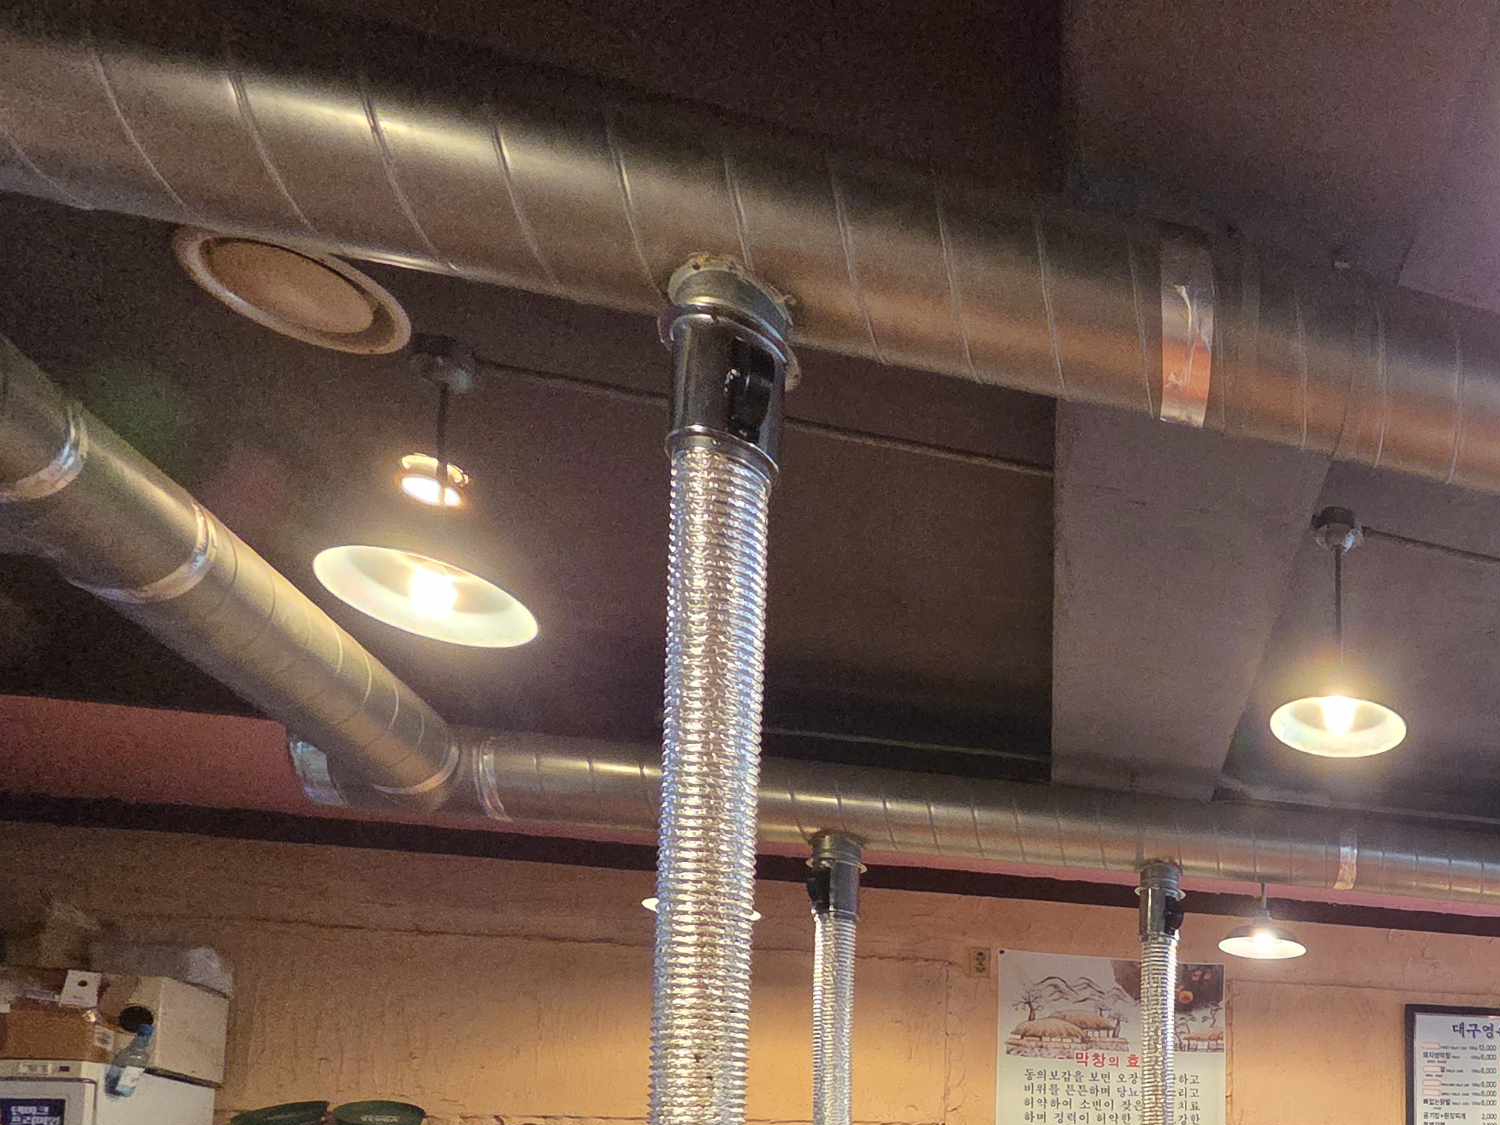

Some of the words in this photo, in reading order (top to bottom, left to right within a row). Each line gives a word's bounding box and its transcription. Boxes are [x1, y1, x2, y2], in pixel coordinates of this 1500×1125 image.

[1075, 1052, 1120, 1068] 막창의
[1024, 1068, 1085, 1083] 동의보감을
[1116, 1073, 1141, 1084] 오장
[1024, 1083, 1060, 1097] 비위를
[1065, 1084, 1111, 1098] 튼튼하며
[1116, 1086, 1140, 1098] 당뇨
[1024, 1097, 1074, 1110] 허약하여
[1079, 1098, 1114, 1111] 소변이
[1177, 1101, 1200, 1111] 치료
[1024, 1111, 1048, 1124] 하며
[1053, 1112, 1090, 1125] 정력이
[1096, 1113, 1131, 1125] 허약한
[1174, 1113, 1200, 1125] 강한
